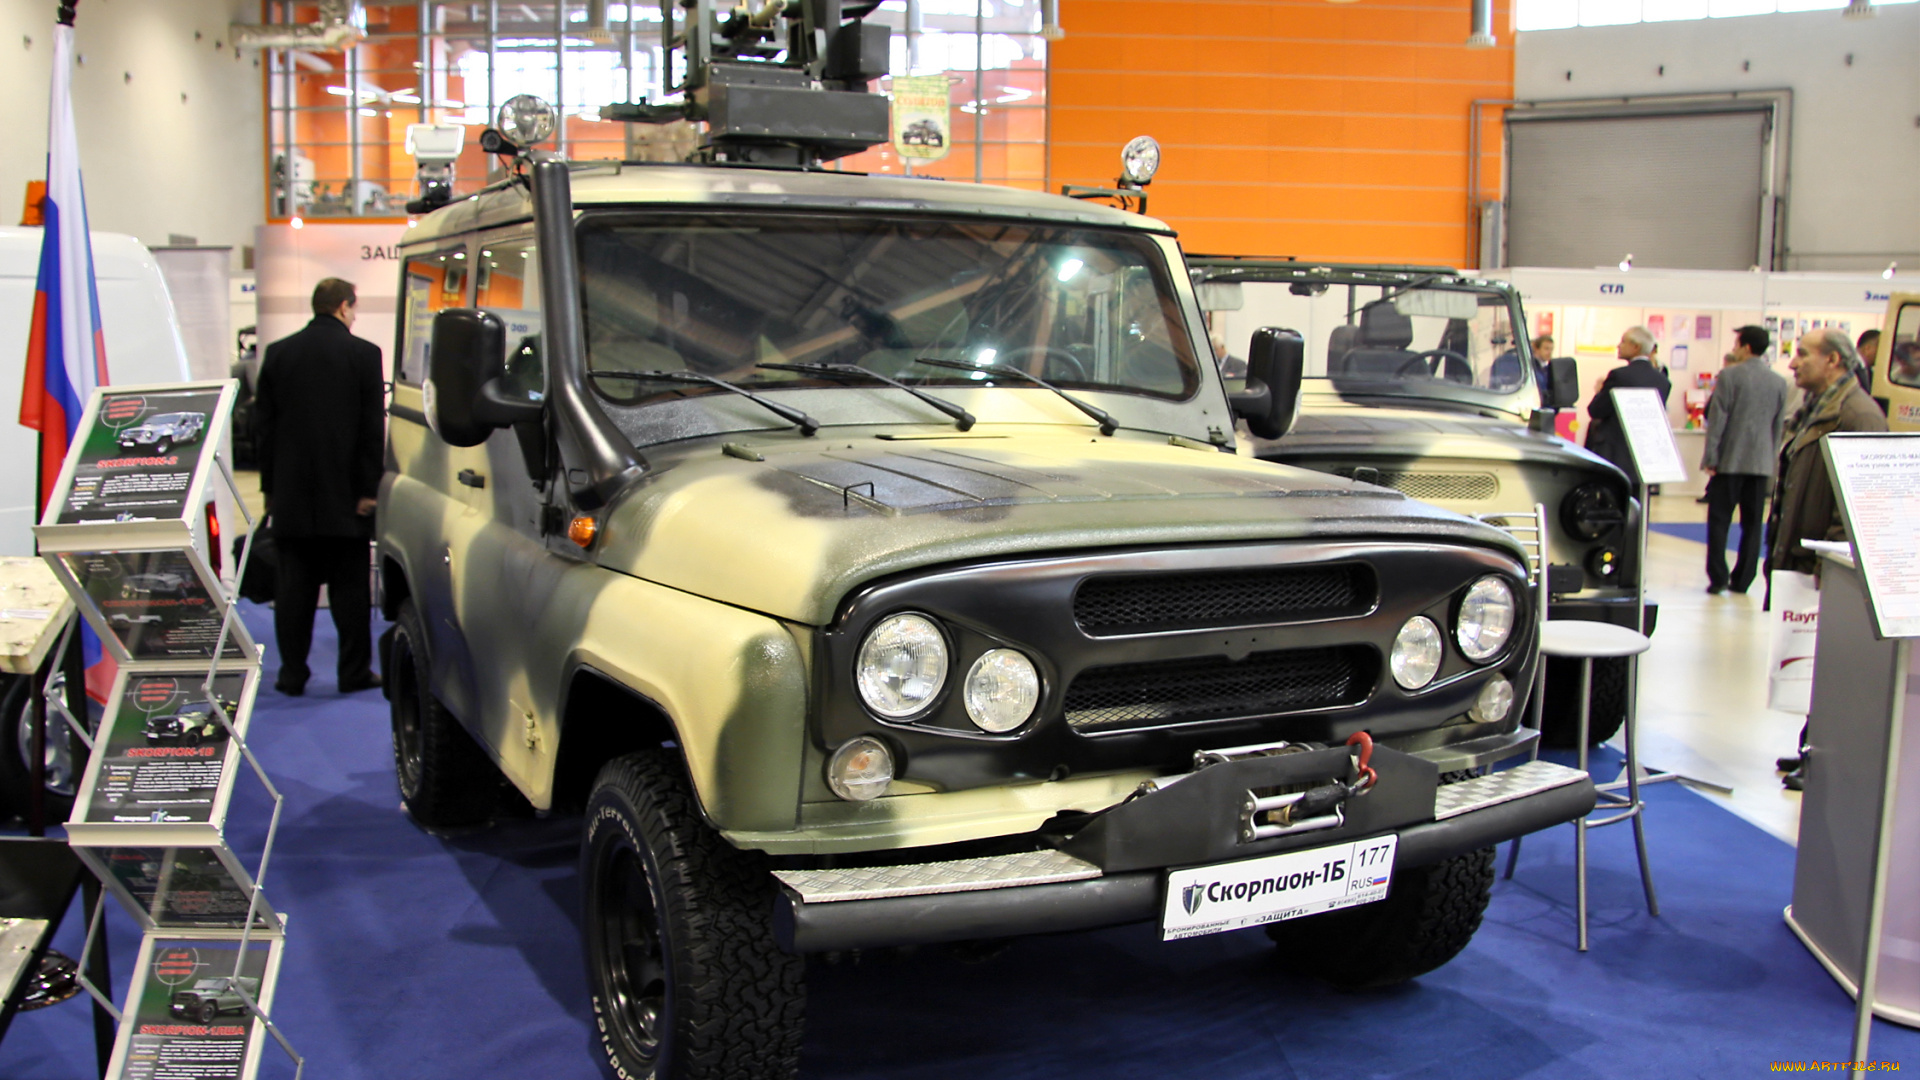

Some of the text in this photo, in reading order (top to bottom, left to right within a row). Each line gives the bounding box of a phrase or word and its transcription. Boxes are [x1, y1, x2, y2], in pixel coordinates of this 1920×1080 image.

[1359, 844, 1390, 867] 177
[1207, 859, 1346, 902] Скорпион-1Б
[1350, 876, 1373, 891] RUS
